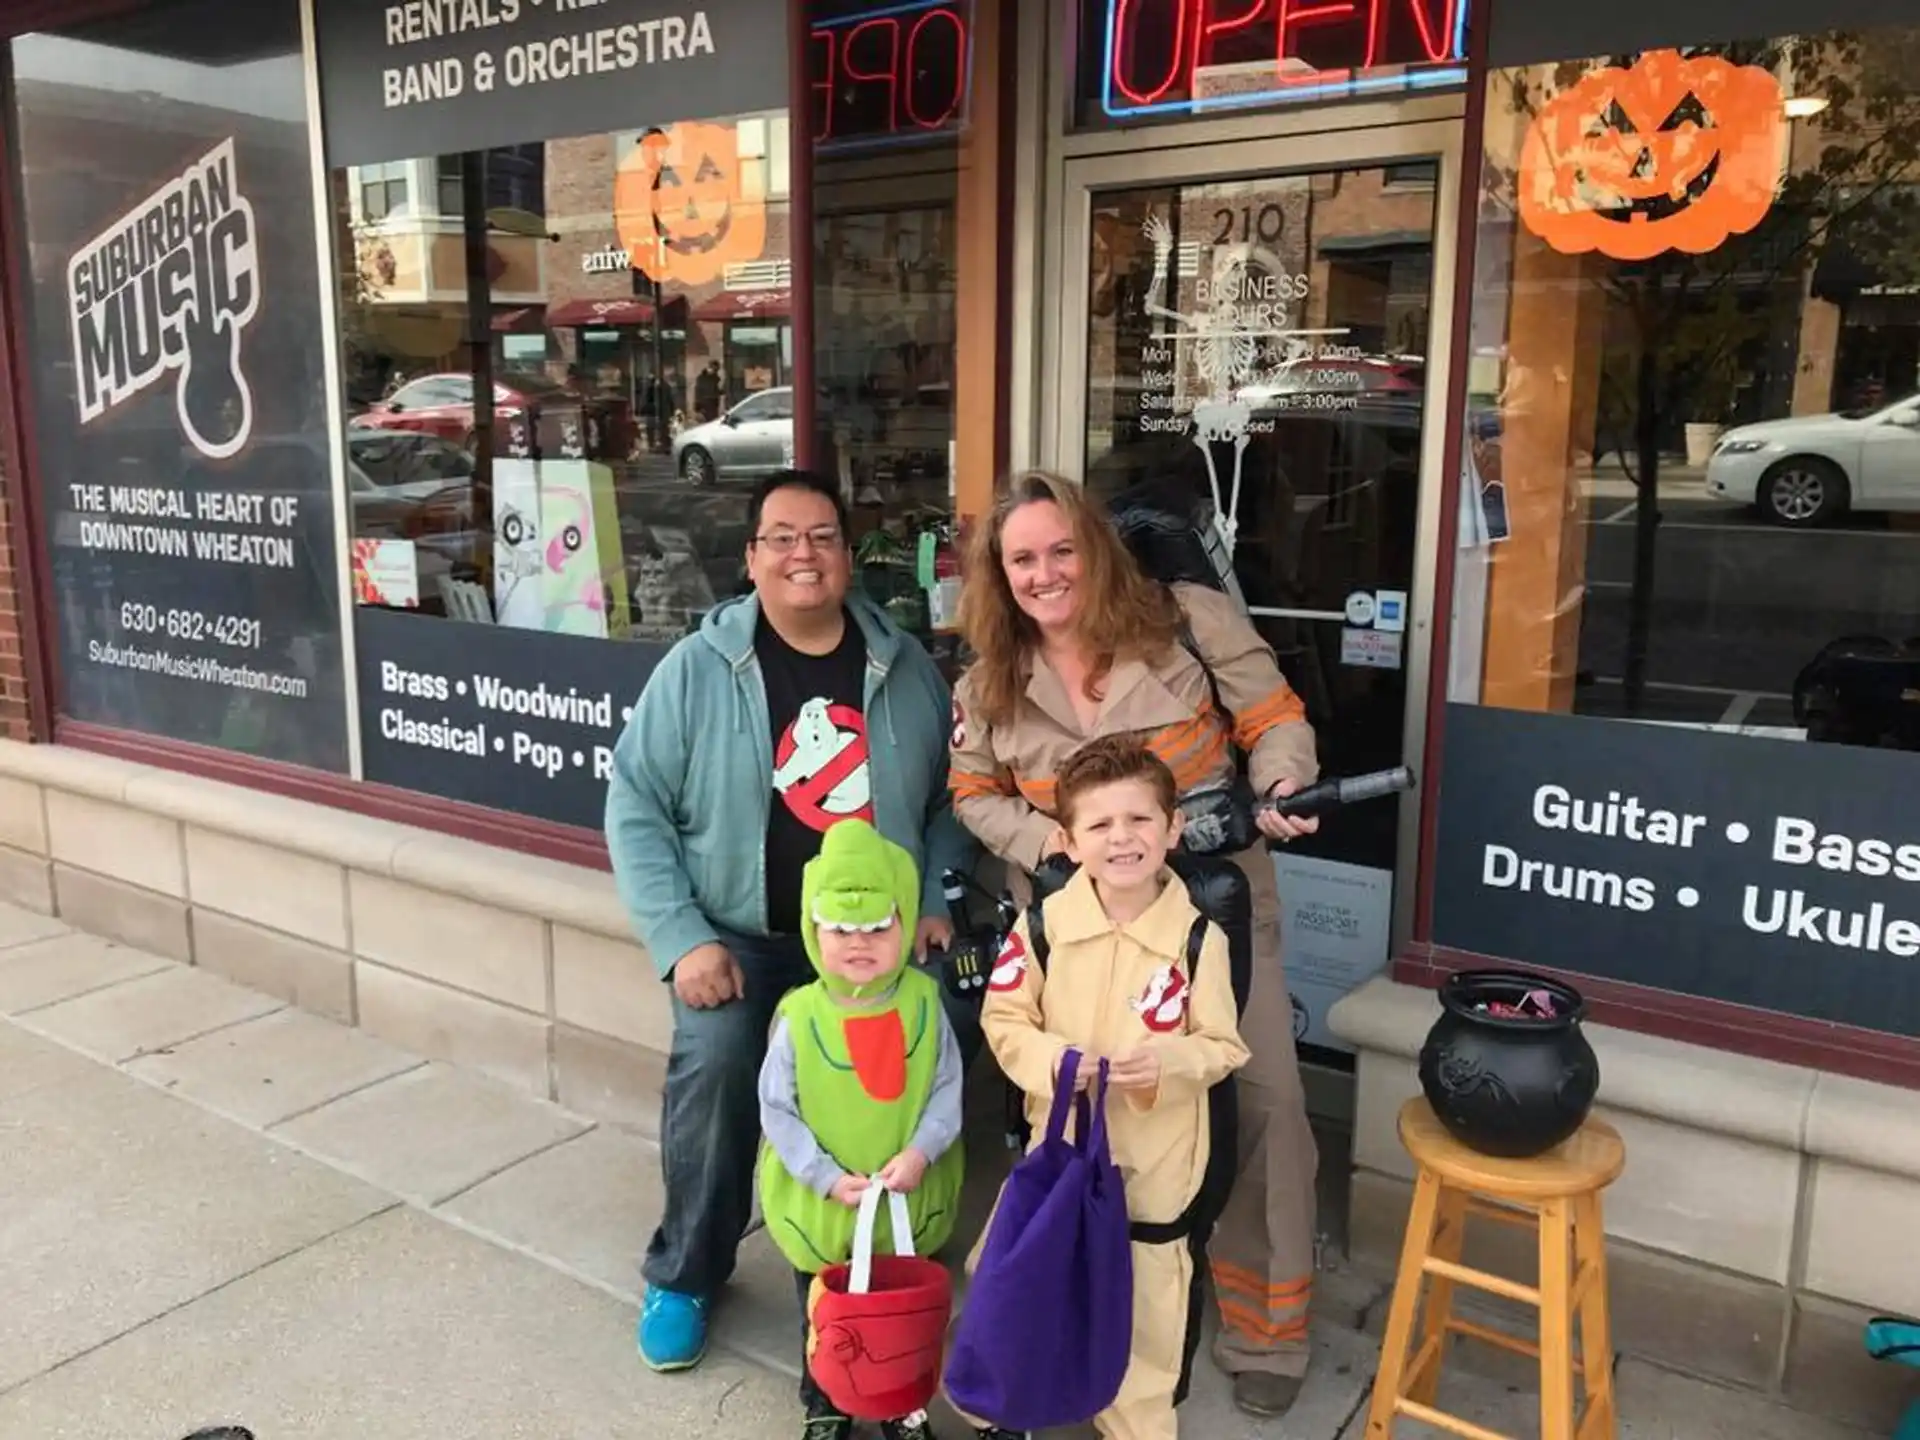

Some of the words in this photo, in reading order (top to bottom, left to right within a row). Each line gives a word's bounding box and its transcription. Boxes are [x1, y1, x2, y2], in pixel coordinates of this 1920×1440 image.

[385, 0, 519, 45] RENTALS
[1113, 0, 1455, 103] OPEN
[383, 58, 463, 107] BAND
[474, 52, 496, 92] &
[505, 12, 715, 87] ORCHESTRA
[73, 156, 231, 315] SUBURBAN
[1213, 203, 1284, 245] 210
[77, 208, 253, 408] MUSIC
[1196, 274, 1309, 301] BUSINESS
[1210, 302, 1287, 329] OURS
[1142, 346, 1171, 362] Mon
[1140, 415, 1191, 438] Sunday
[1226, 417, 1276, 434] Cosed
[70, 483, 105, 512] THE
[109, 486, 191, 519] MUSICAL
[196, 492, 265, 525] HEART
[270, 496, 298, 527] OF
[80, 521, 189, 558] DOWNTOWN
[192, 531, 295, 568] WHEATON
[89, 639, 307, 698] SuburbanMusicWheaton.com
[381, 660, 449, 701] Brass
[473, 674, 612, 728] Woodwind
[381, 708, 486, 757] Classical
[513, 731, 564, 778] Pop
[1532, 784, 1706, 848] Guitar
[1772, 816, 1920, 882] Bass
[1482, 844, 1656, 912] Drums
[1742, 885, 1920, 957] Ukule
